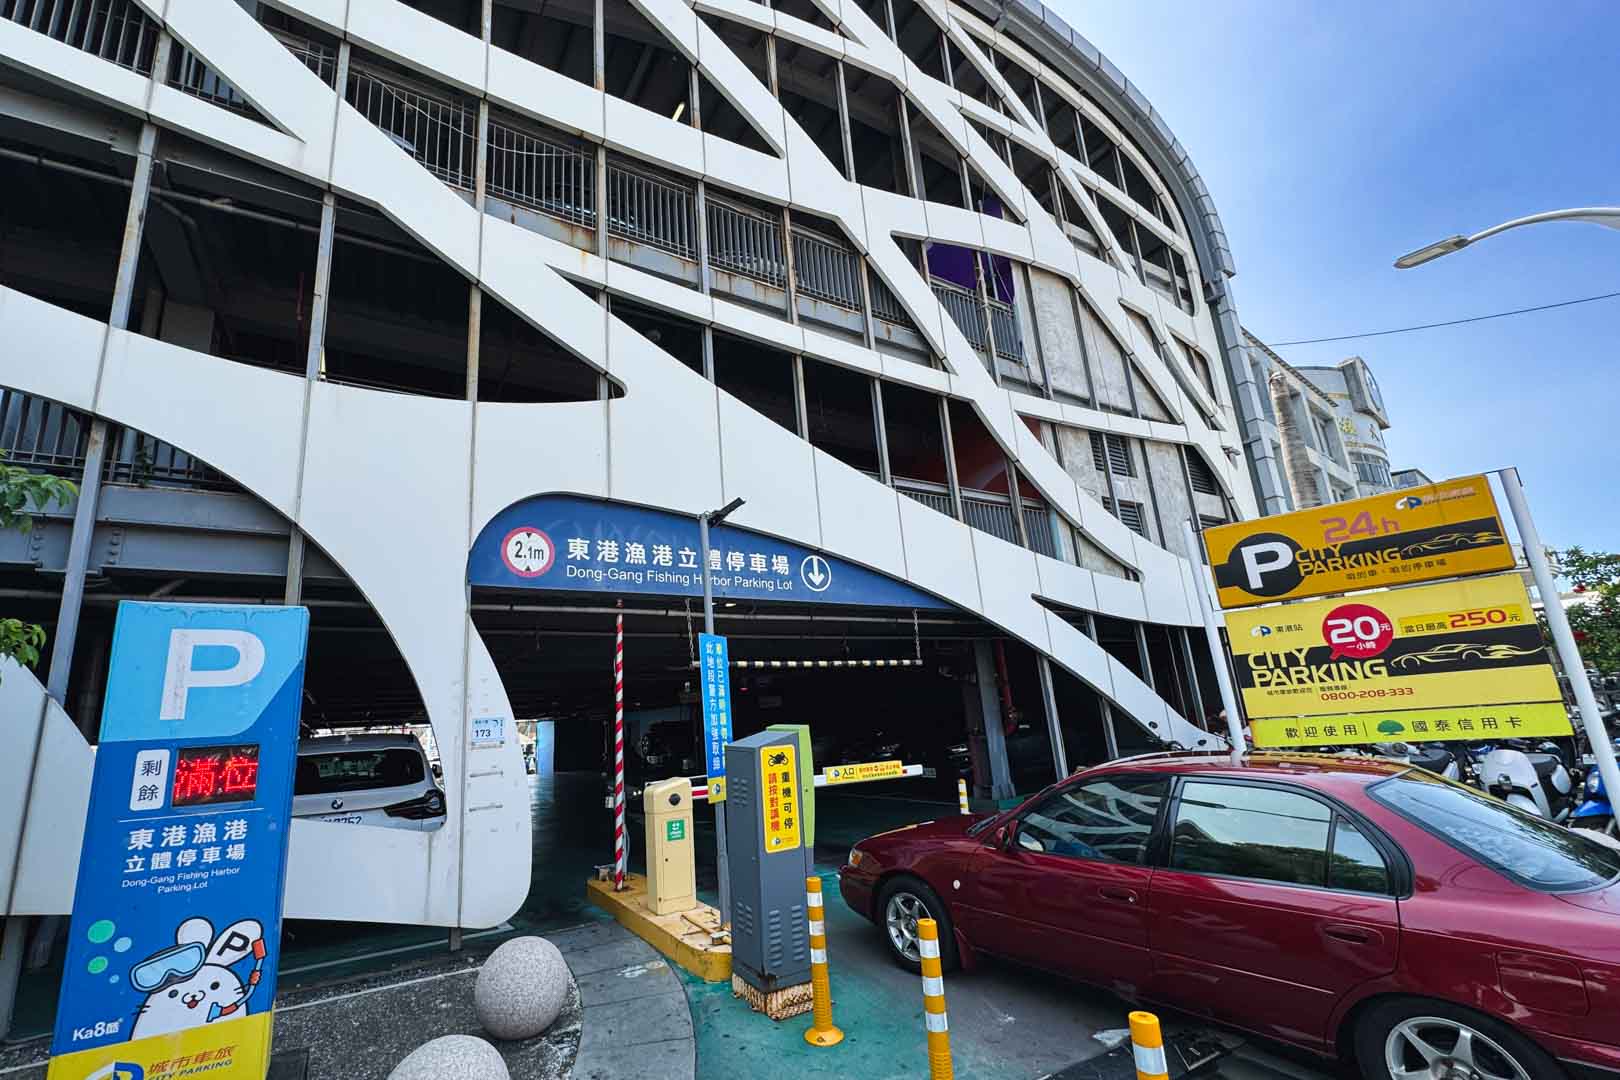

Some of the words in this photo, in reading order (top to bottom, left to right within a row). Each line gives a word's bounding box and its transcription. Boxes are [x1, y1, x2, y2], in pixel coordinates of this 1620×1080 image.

[514, 540, 545, 563] 2.1m
[567, 538, 790, 576] 東港漁港立體停車場
[1241, 541, 1294, 590] P
[1295, 543, 1343, 563] CITY
[1298, 547, 1402, 577] PARKING
[566, 565, 643, 583] Dong-Gang
[647, 570, 690, 586] Fishing
[693, 573, 732, 586] Hrbor
[735, 576, 774, 591] Parking
[777, 579, 793, 590] Lot
[1247, 647, 1312, 671] CITY
[159, 627, 266, 721] P
[1252, 659, 1390, 689] PARKING
[1321, 687, 1415, 702] 0800-208-333
[475, 729, 491, 737] 173
[1285, 724, 1358, 739] 歡迎使用
[1412, 717, 1523, 733] 國泰信用卡
[137, 759, 162, 801] 剩餘
[175, 756, 259, 798] 滿位
[781, 771, 793, 830] 重機可停
[128, 818, 248, 851] 東港漁港
[123, 843, 246, 873] 立體停車場
[121, 874, 176, 888] Dong-Gang
[177, 870, 209, 881] Fishing
[210, 866, 241, 877] Harbor
[157, 883, 192, 894] Parking
[193, 880, 208, 889] Lot
[179, 1058, 234, 1076] PARKING
